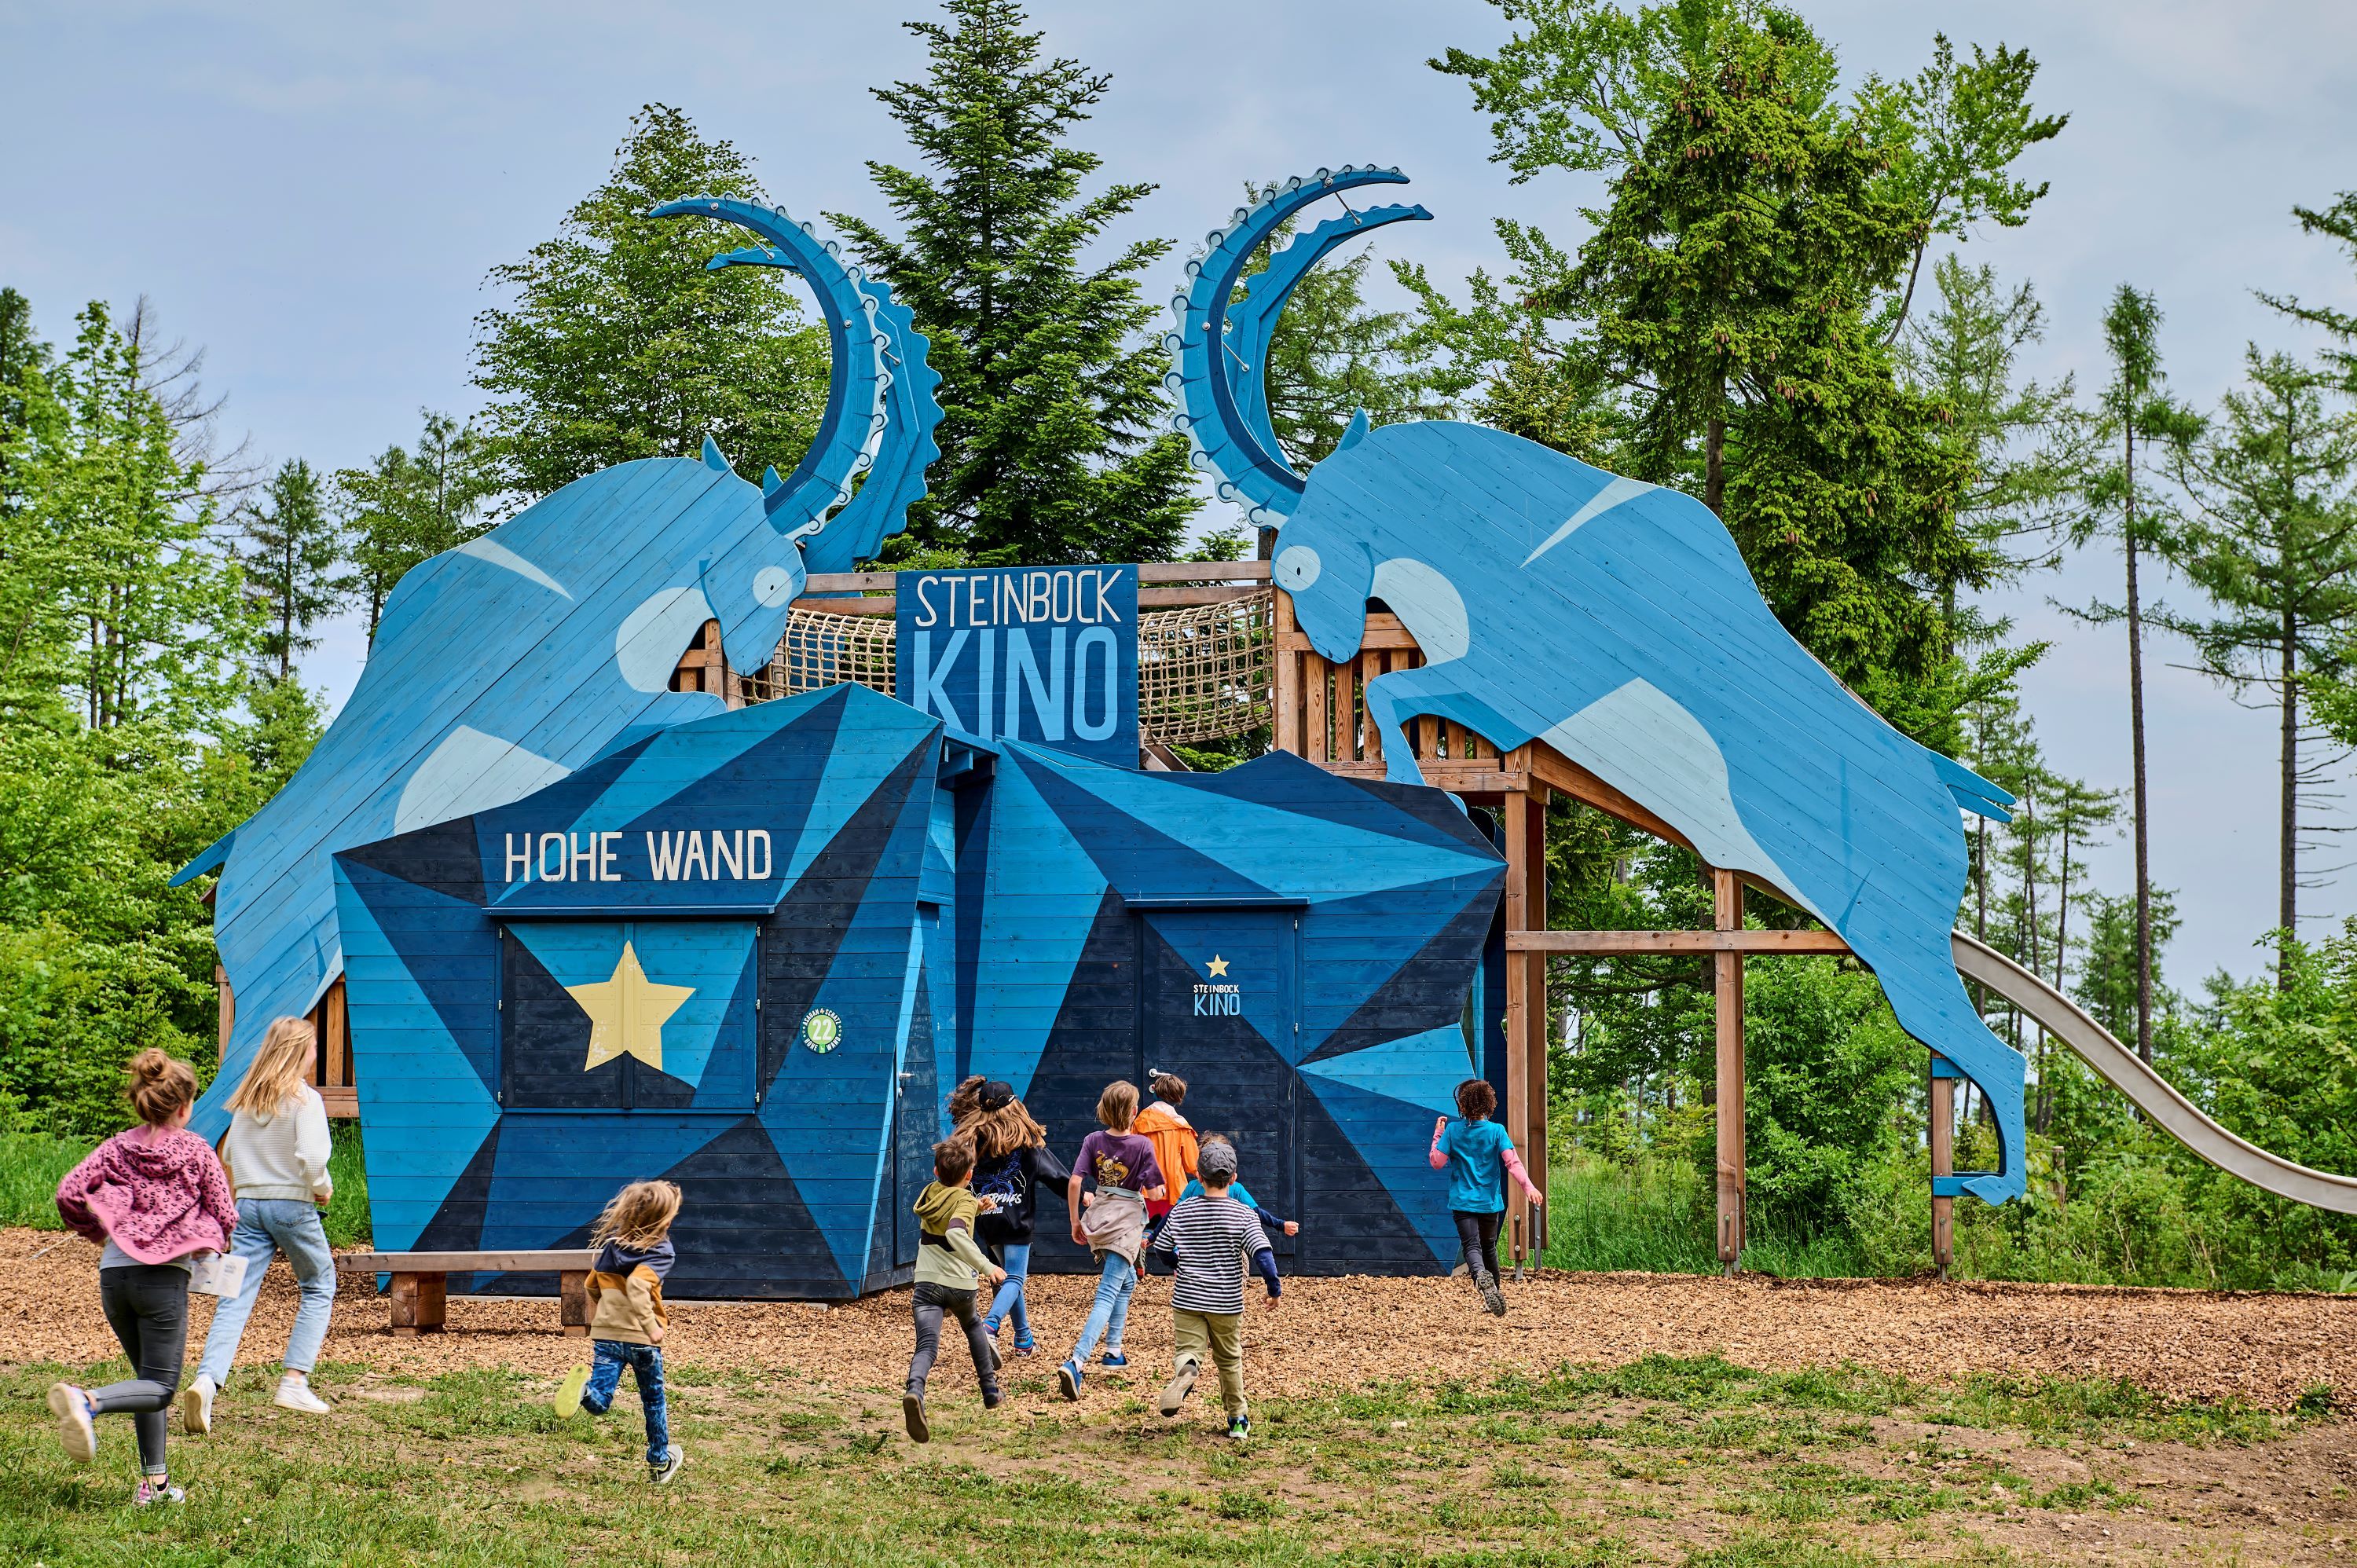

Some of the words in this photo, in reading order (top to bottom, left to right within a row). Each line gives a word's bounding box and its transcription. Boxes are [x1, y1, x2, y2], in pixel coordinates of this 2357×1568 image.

[915, 570, 1123, 627] STEINBOCK
[913, 626, 1118, 742] KINO
[505, 831, 623, 882] HOHE
[646, 830, 772, 881] WAND
[1193, 984, 1240, 993] STEINBOCK
[1194, 993, 1241, 1016] KINO
[825, 1009, 841, 1025] SCHATZ
[812, 1019, 832, 1041] 22
[804, 1038, 819, 1051] HOHE
[826, 1036, 841, 1051] WAND
